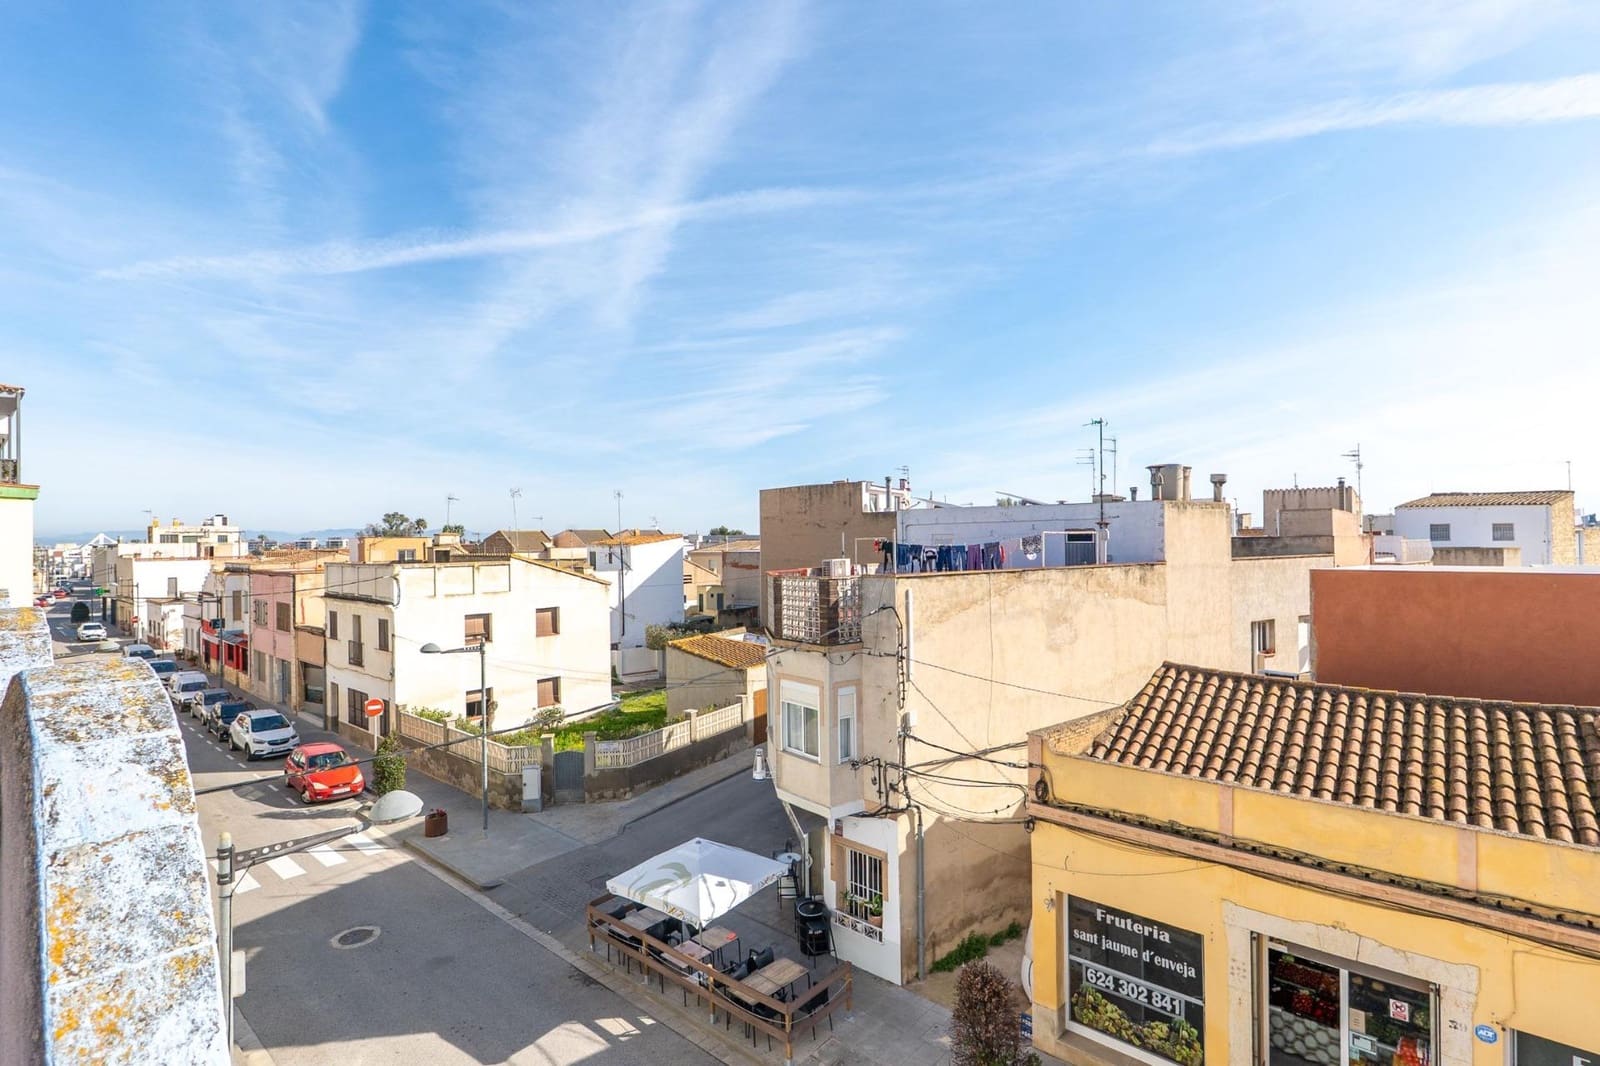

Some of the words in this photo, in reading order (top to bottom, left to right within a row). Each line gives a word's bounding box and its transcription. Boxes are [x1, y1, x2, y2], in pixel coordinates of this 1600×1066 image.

[1073, 928, 1098, 945] sant
[1102, 935, 1139, 958] jaume
[1096, 908, 1171, 944] Fruteria
[1087, 968, 1114, 991] 624
[1118, 979, 1148, 1003] 302
[1152, 992, 1180, 1015] 841
